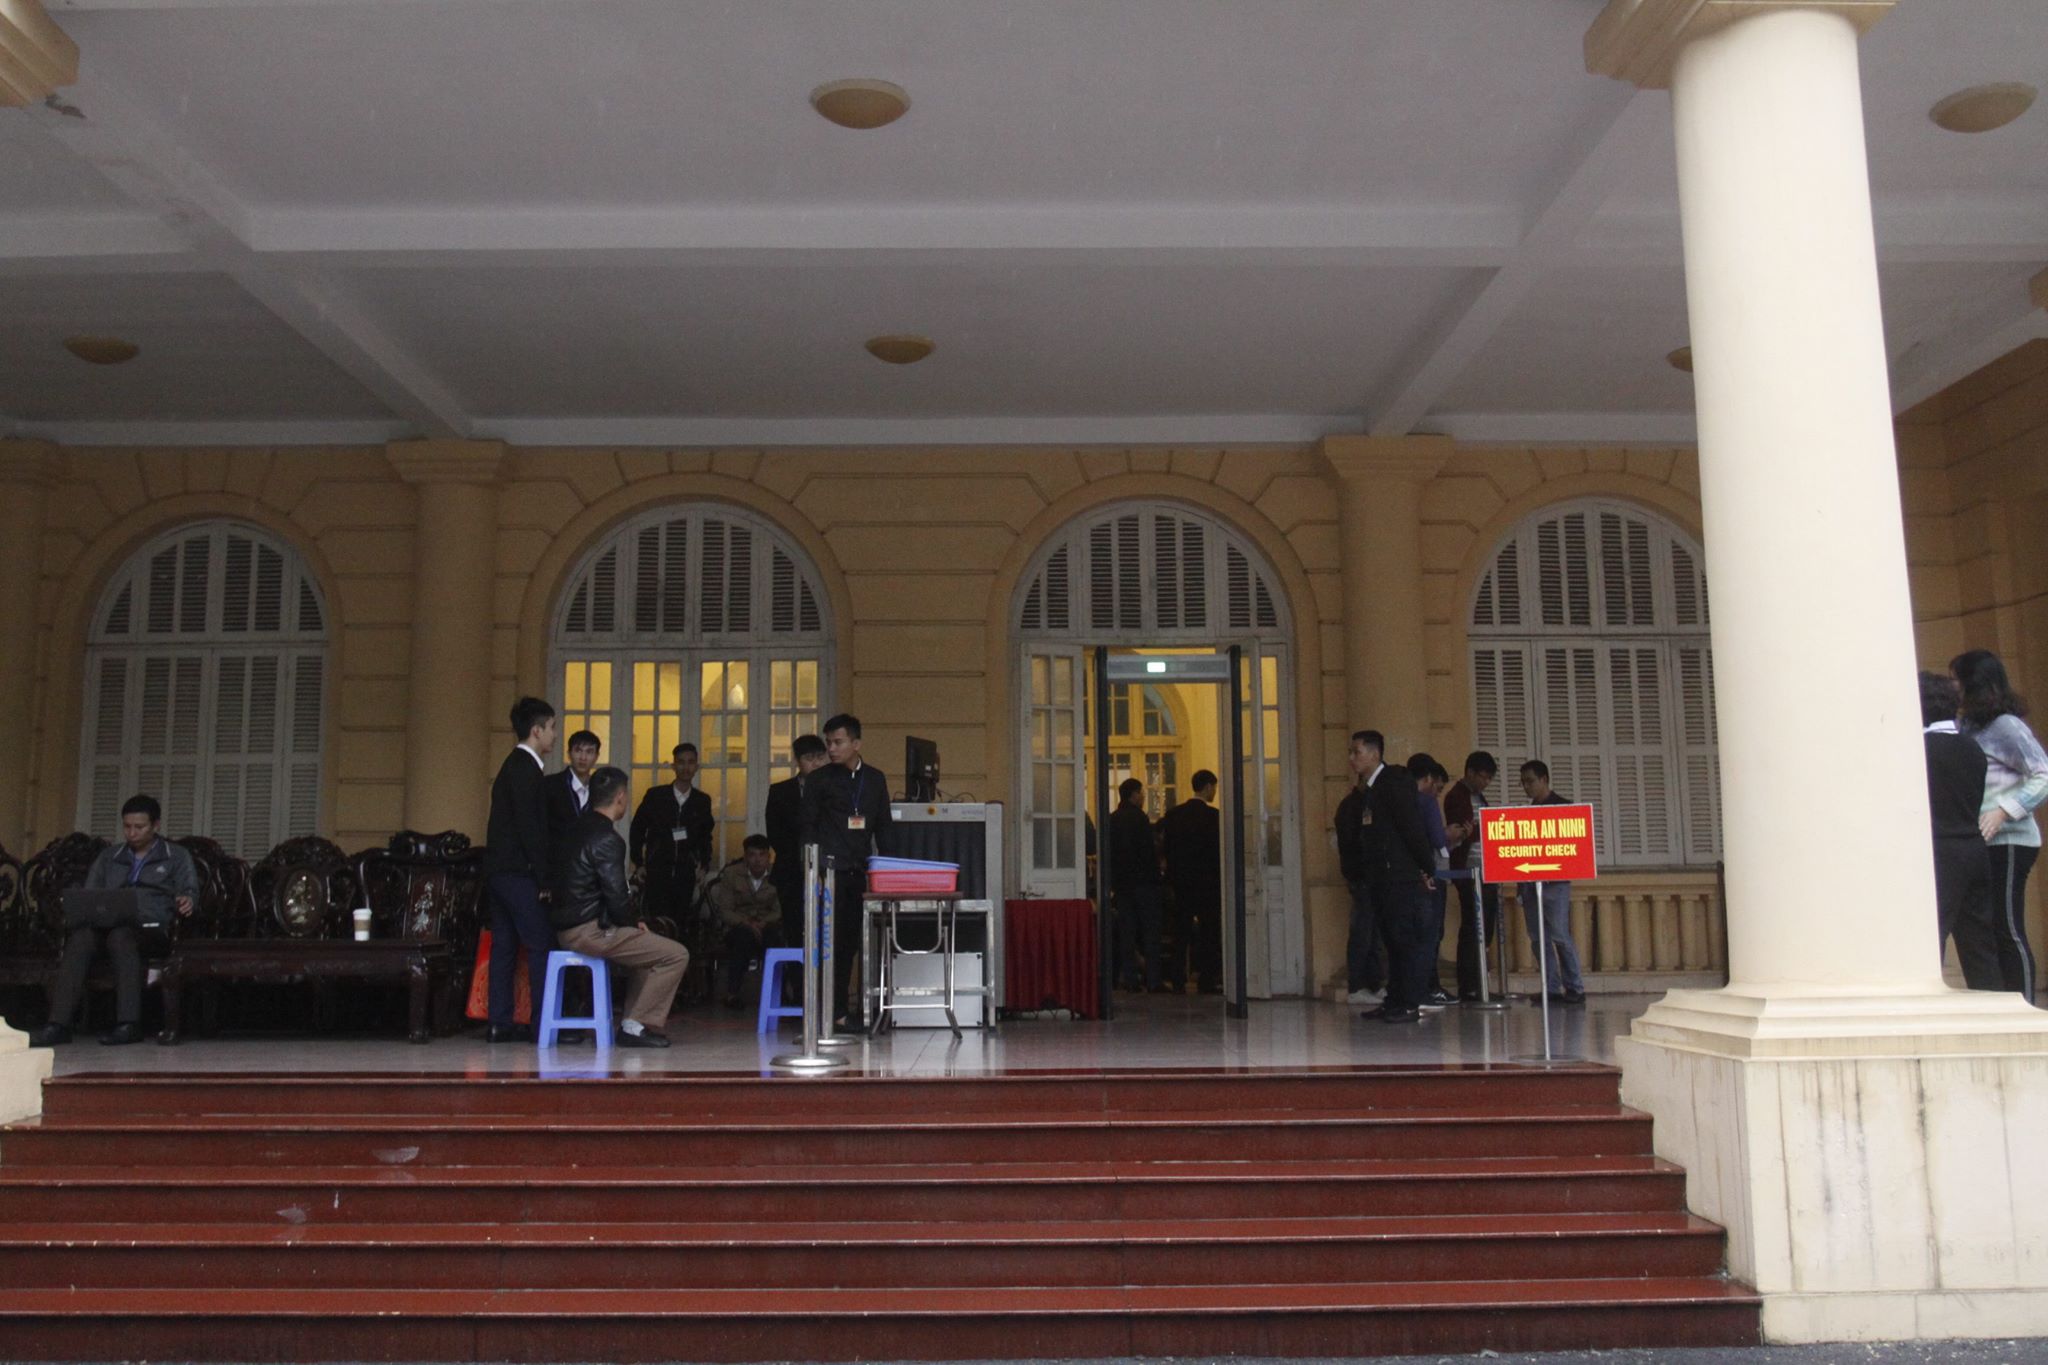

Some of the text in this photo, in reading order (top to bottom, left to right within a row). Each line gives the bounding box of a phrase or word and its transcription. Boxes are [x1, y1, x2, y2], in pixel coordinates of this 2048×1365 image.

[1517, 820, 1538, 839] TRA
[1541, 819, 1556, 839] AN
[1558, 818, 1586, 838] NINH
[1498, 844, 1577, 858] SECURITY CHECK
